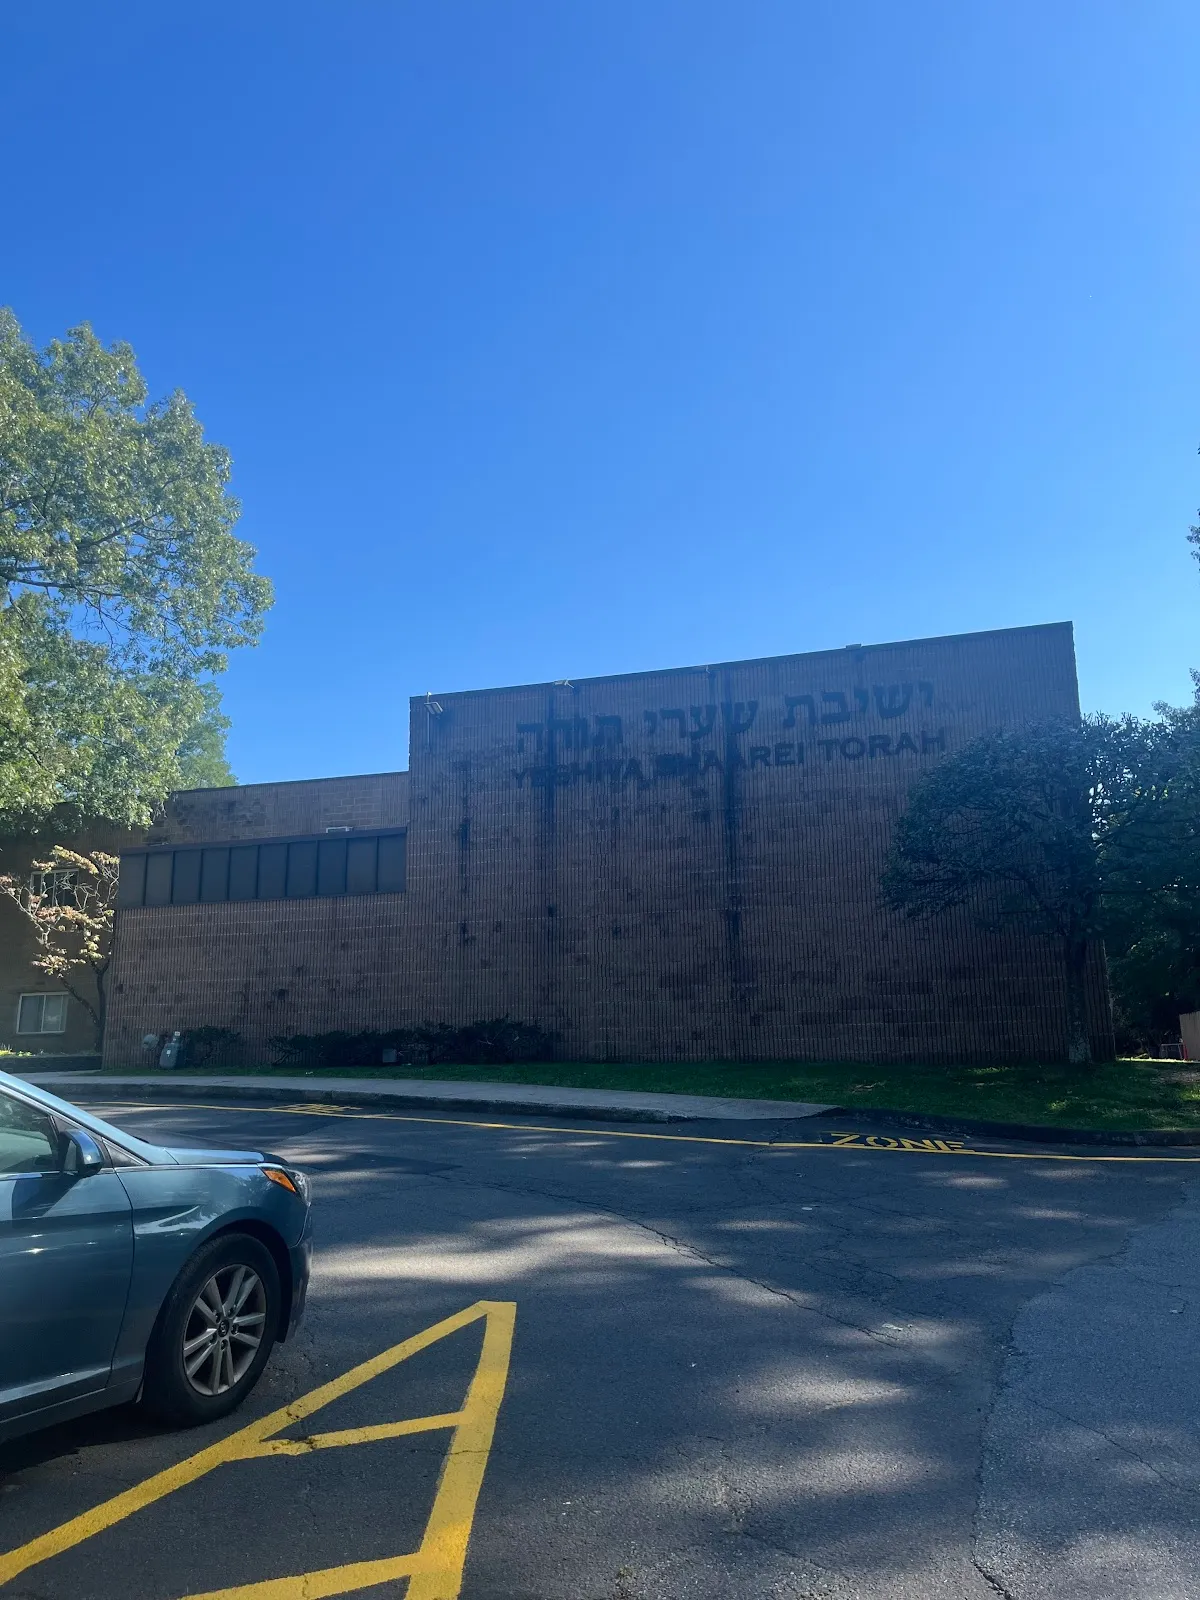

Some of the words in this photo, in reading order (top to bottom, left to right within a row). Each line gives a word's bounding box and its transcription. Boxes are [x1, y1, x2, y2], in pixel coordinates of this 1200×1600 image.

[643, 700, 758, 740] שערי
[783, 681, 933, 729] ישיבת
[517, 715, 623, 753] תורה
[511, 758, 643, 789] YESHIVA
[817, 727, 946, 763] TORAH
[831, 1133, 975, 1153] ZONE
